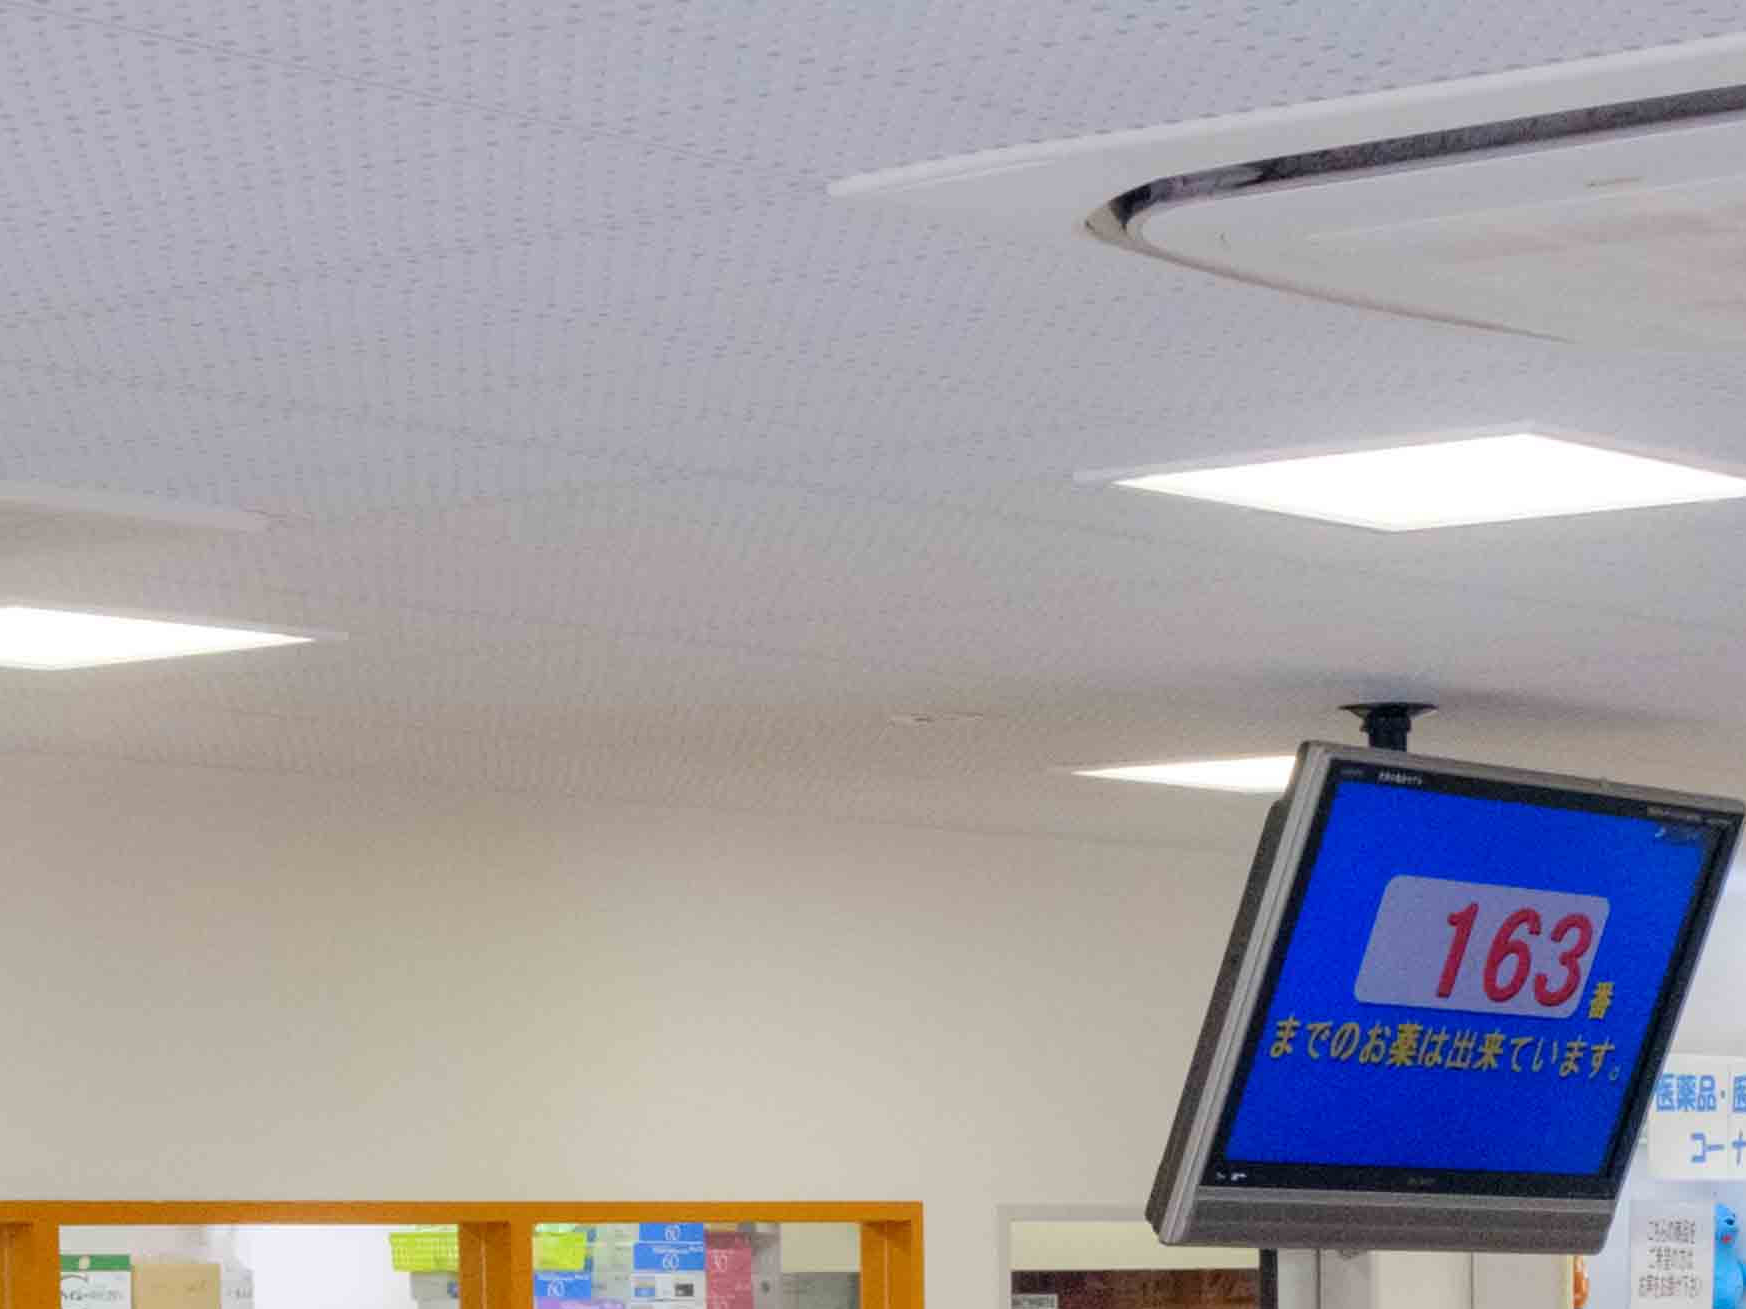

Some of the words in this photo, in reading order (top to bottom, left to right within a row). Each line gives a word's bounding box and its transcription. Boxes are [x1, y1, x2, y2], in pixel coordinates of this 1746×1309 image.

[1435, 903, 1594, 1007] 163
[1587, 981, 1615, 1021] 番
[1268, 1016, 1621, 1081] までのお薬は出来ています。
[661, 1254, 680, 1271] 60
